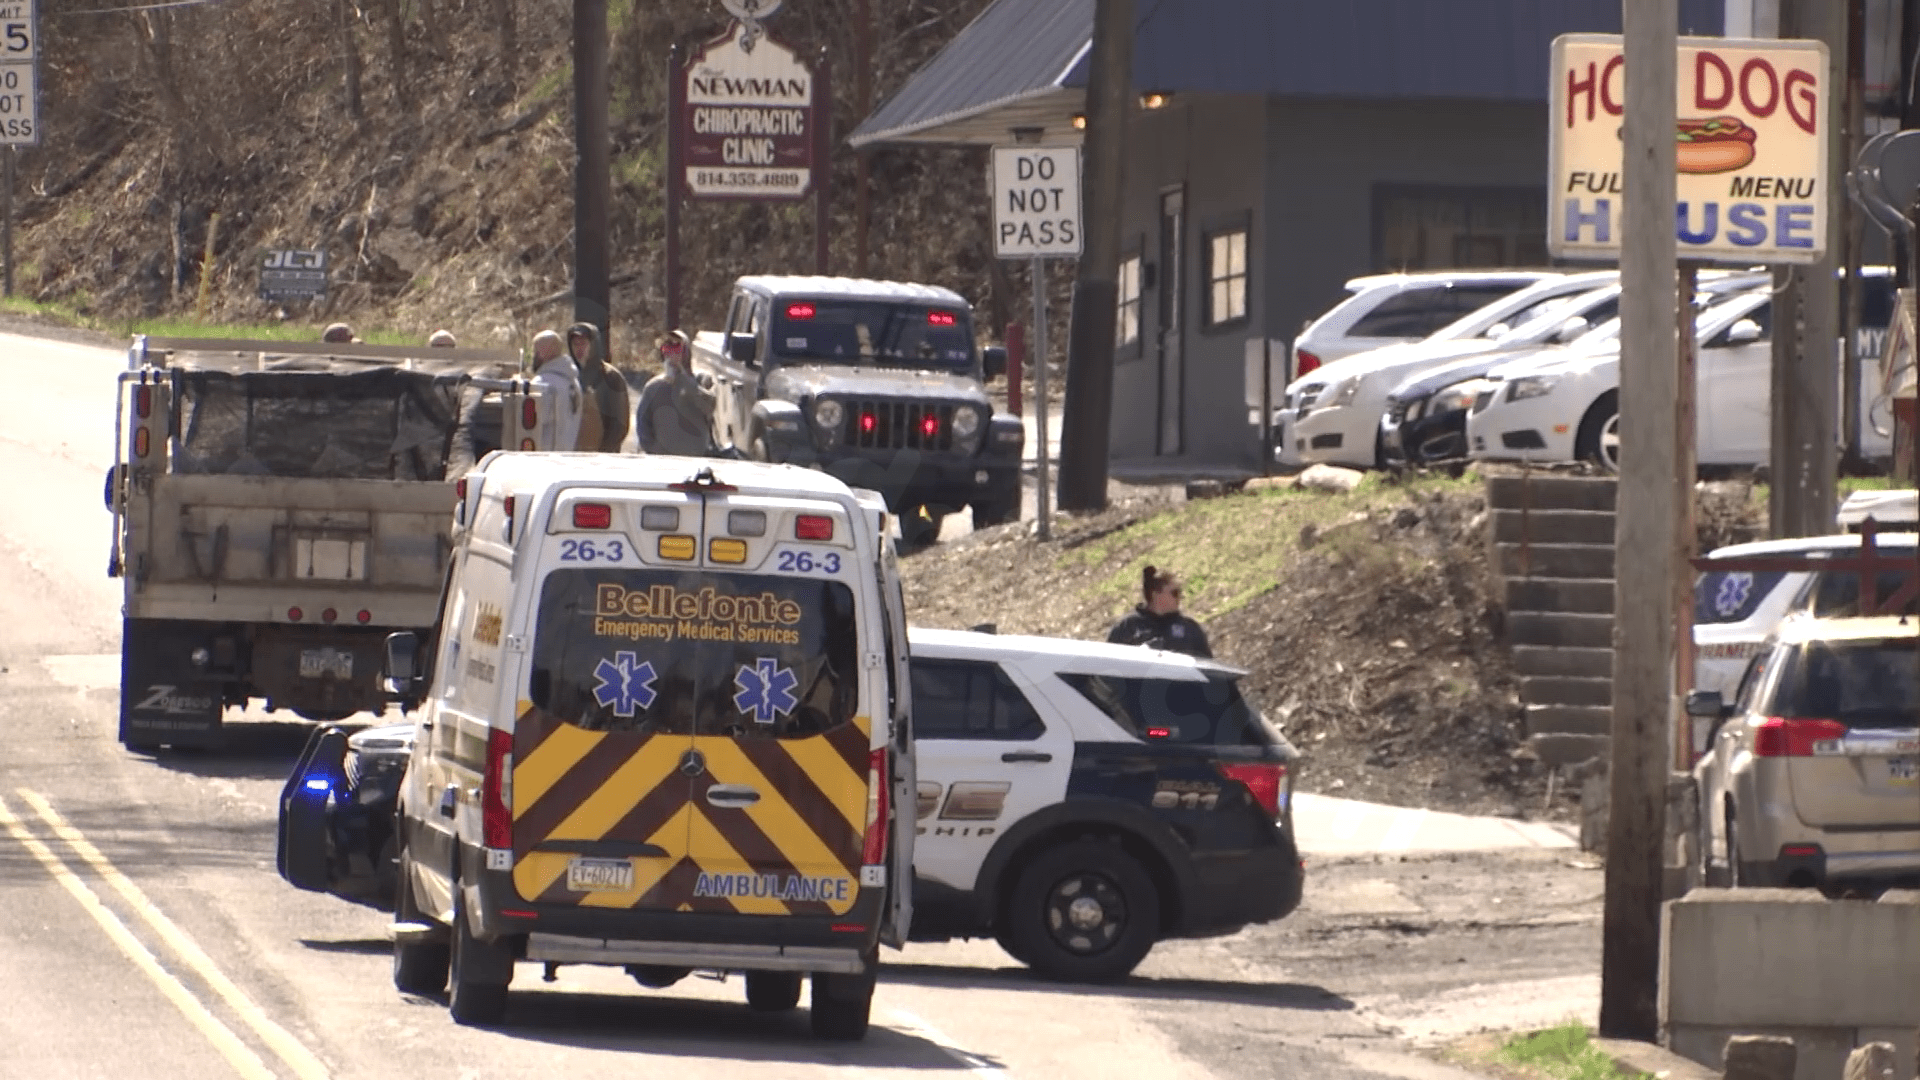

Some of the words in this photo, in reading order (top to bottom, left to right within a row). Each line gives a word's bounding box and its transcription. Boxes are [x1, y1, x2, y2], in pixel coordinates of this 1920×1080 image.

[0, 23, 29, 52] 5
[693, 77, 806, 97] NEWMAN
[1695, 51, 1816, 135] DOG
[694, 108, 804, 135] CHIROPRACTIC
[722, 138, 775, 164] CLINIC
[1017, 156, 1055, 180] DO
[1009, 188, 1064, 213] NOT
[1730, 176, 1815, 199] MENU
[1000, 219, 1075, 245] PASS
[1564, 199, 1814, 248] HUSE
[560, 539, 624, 562] 26-3
[777, 550, 842, 574] 26-3
[596, 582, 801, 626] Bellefonte
[594, 617, 675, 642] Emergency
[677, 621, 735, 642] Medical
[737, 624, 800, 645] Services
[694, 872, 850, 902] AMBULANCE
